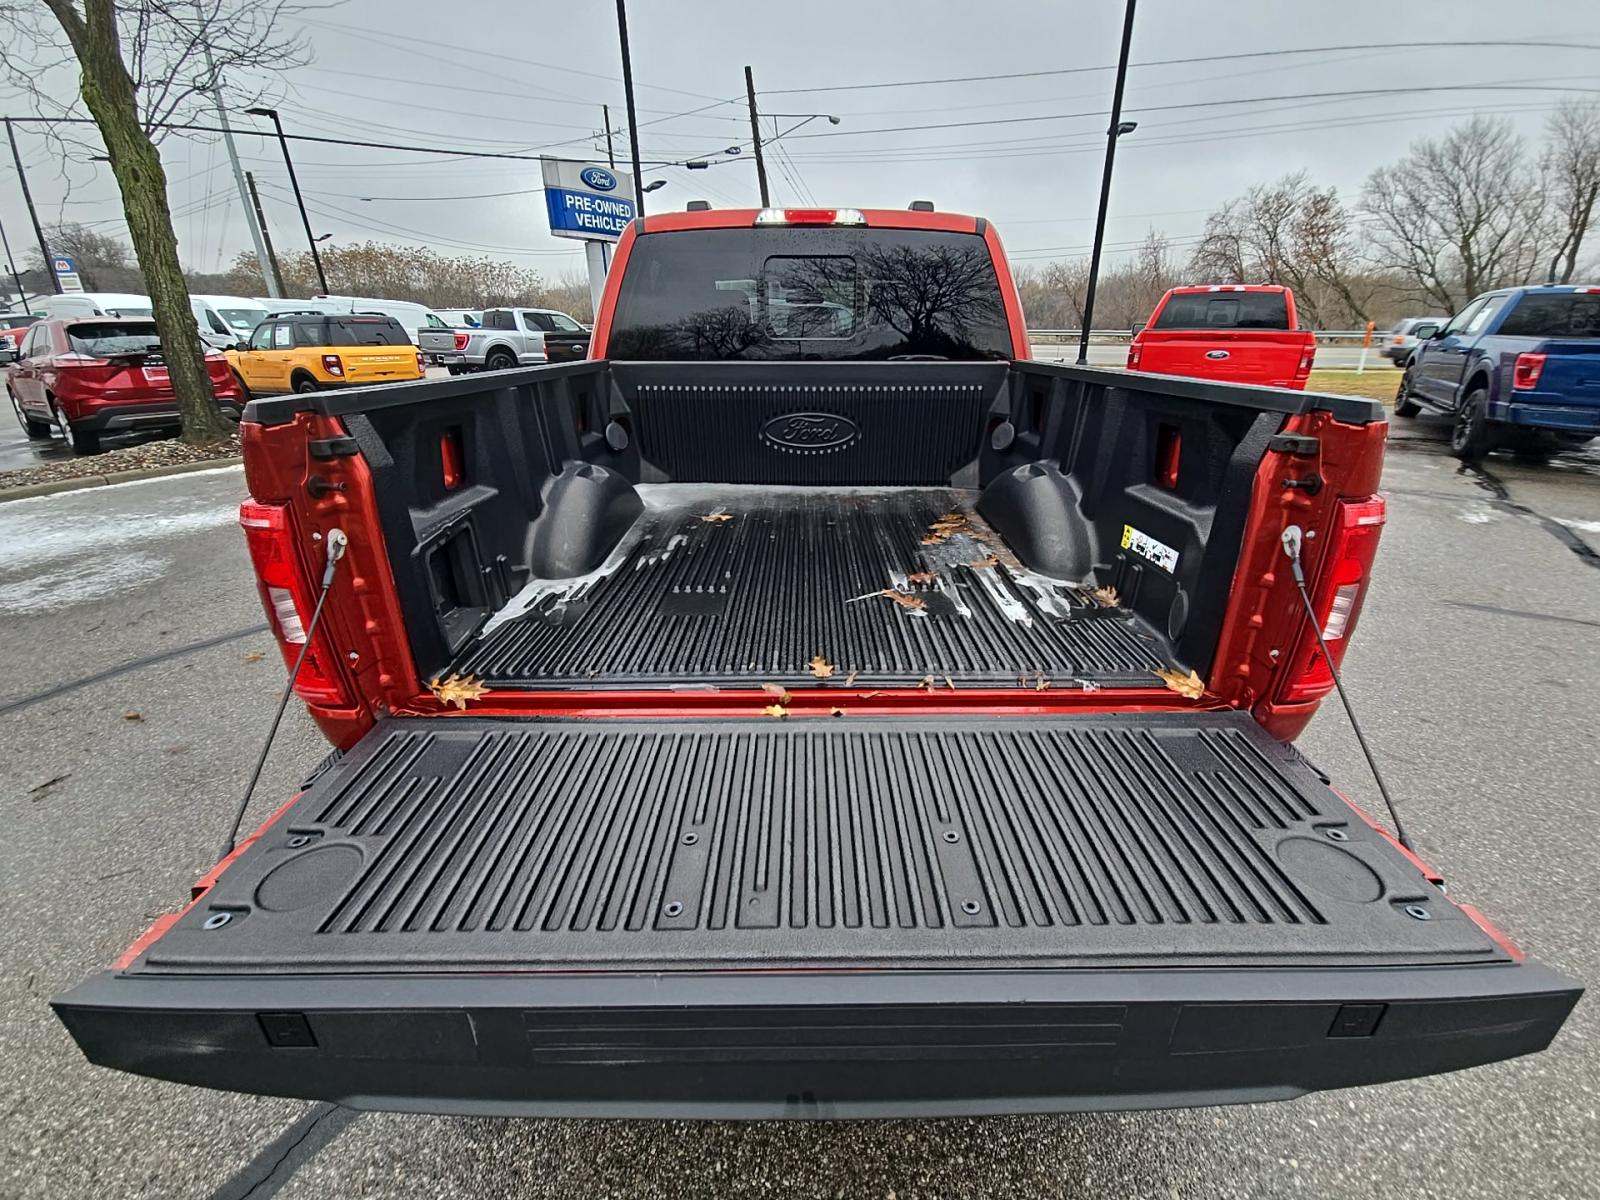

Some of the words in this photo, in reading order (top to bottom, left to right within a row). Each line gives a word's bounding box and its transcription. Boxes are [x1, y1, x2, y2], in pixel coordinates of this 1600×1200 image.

[591, 171, 610, 186] Ford
[565, 194, 631, 218] PRE-OWNED
[575, 212, 628, 231] VEHICLES
[783, 416, 839, 440] Ford
